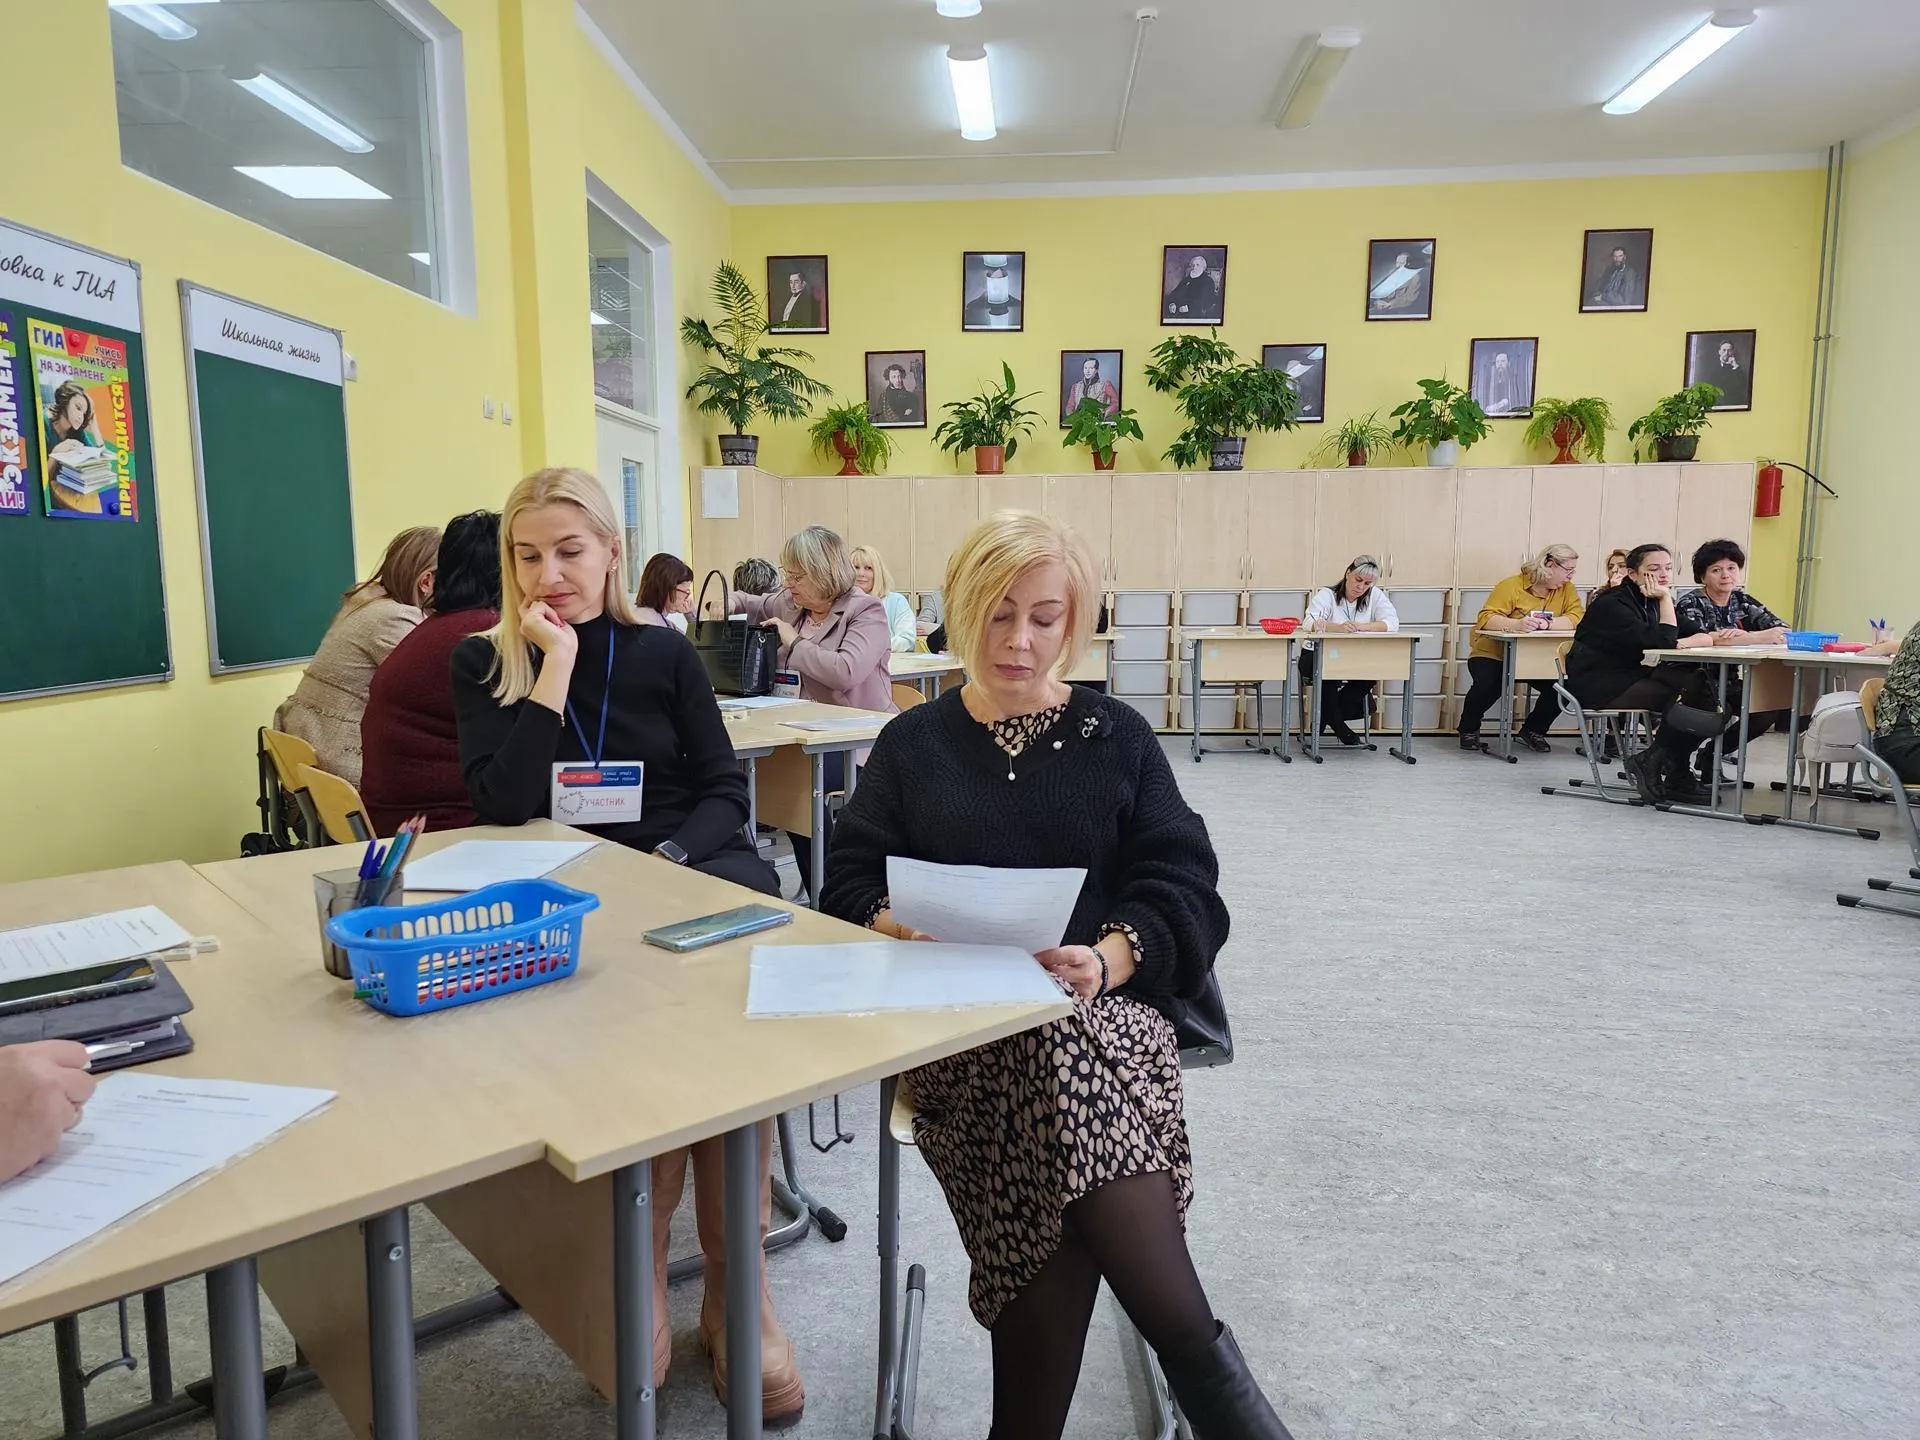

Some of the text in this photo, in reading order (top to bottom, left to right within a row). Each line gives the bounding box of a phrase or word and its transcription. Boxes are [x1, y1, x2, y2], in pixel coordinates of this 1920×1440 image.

[53, 272, 64, 287] к
[72, 270, 116, 301] ГИА
[33, 327, 65, 350] ГИА
[221, 318, 321, 363] Школьная жизнь
[94, 346, 122, 359] УЧИСЬ
[40, 359, 105, 382] НА ЭКЗАМЕНЕ
[111, 376, 133, 517] ПРИГОДИТСЯ!
[585, 798, 625, 807] УЧАСТНИК
